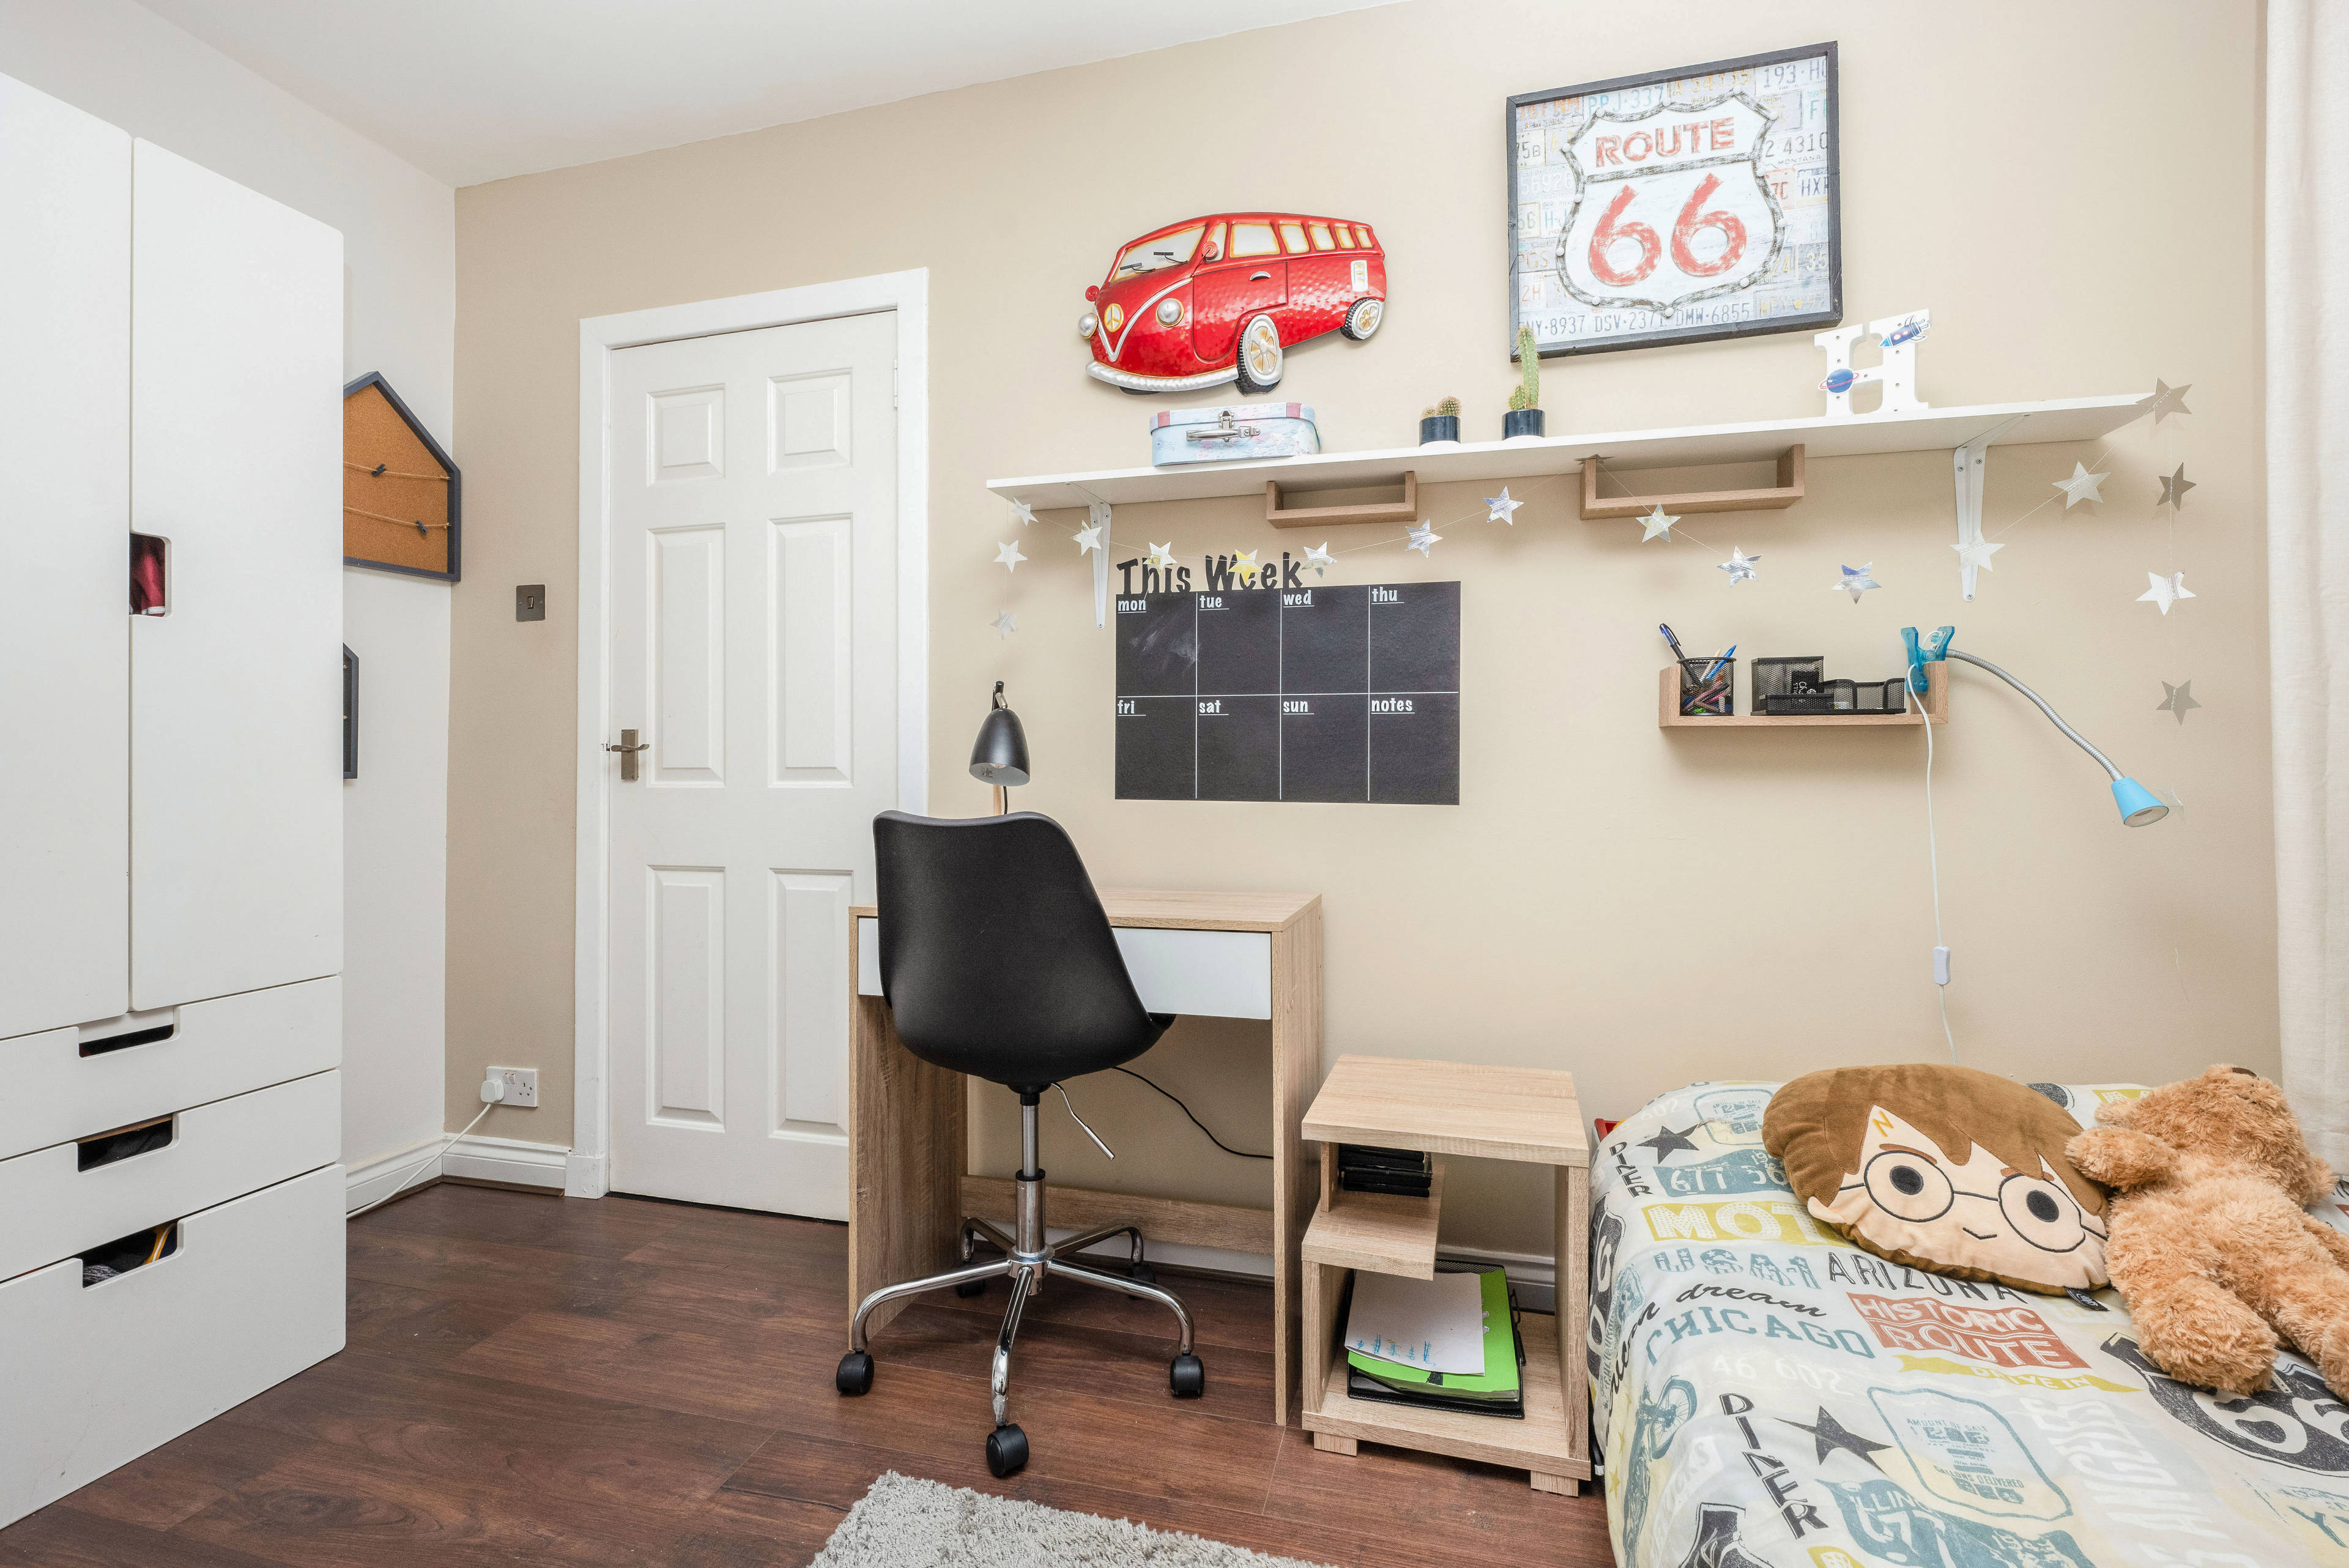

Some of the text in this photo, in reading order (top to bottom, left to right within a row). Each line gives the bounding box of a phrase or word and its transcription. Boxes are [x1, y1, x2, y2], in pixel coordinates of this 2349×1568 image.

[1595, 116, 1735, 168] ROUTE
[1588, 173, 1748, 287] 66
[1116, 557, 1191, 595] This
[1117, 598, 1147, 611] mon
[1199, 595, 1223, 609] tue
[1283, 589, 1312, 605] wed
[1371, 586, 1398, 603] thu
[1117, 699, 1135, 715] fri
[1199, 699, 1221, 714] sat
[1283, 699, 1309, 713] sun
[1371, 697, 1413, 712] notes
[1609, 1141, 1653, 1198] DINER
[1647, 1200, 1825, 1242] MOT
[1675, 1283, 1827, 1318] dream
[1856, 1297, 2045, 1332] HISTORIC
[1646, 1306, 1876, 1367] CHICAGO
[1880, 1324, 2071, 1367] ROUTE
[2061, 1374, 2093, 1389] IN
[1907, 1418, 1947, 1427] AMOUNT
[1965, 1424, 1989, 1433] SALE
[1719, 1392, 1829, 1540] DINER
[1933, 1465, 2025, 1489] GALLONS DELIVERED
